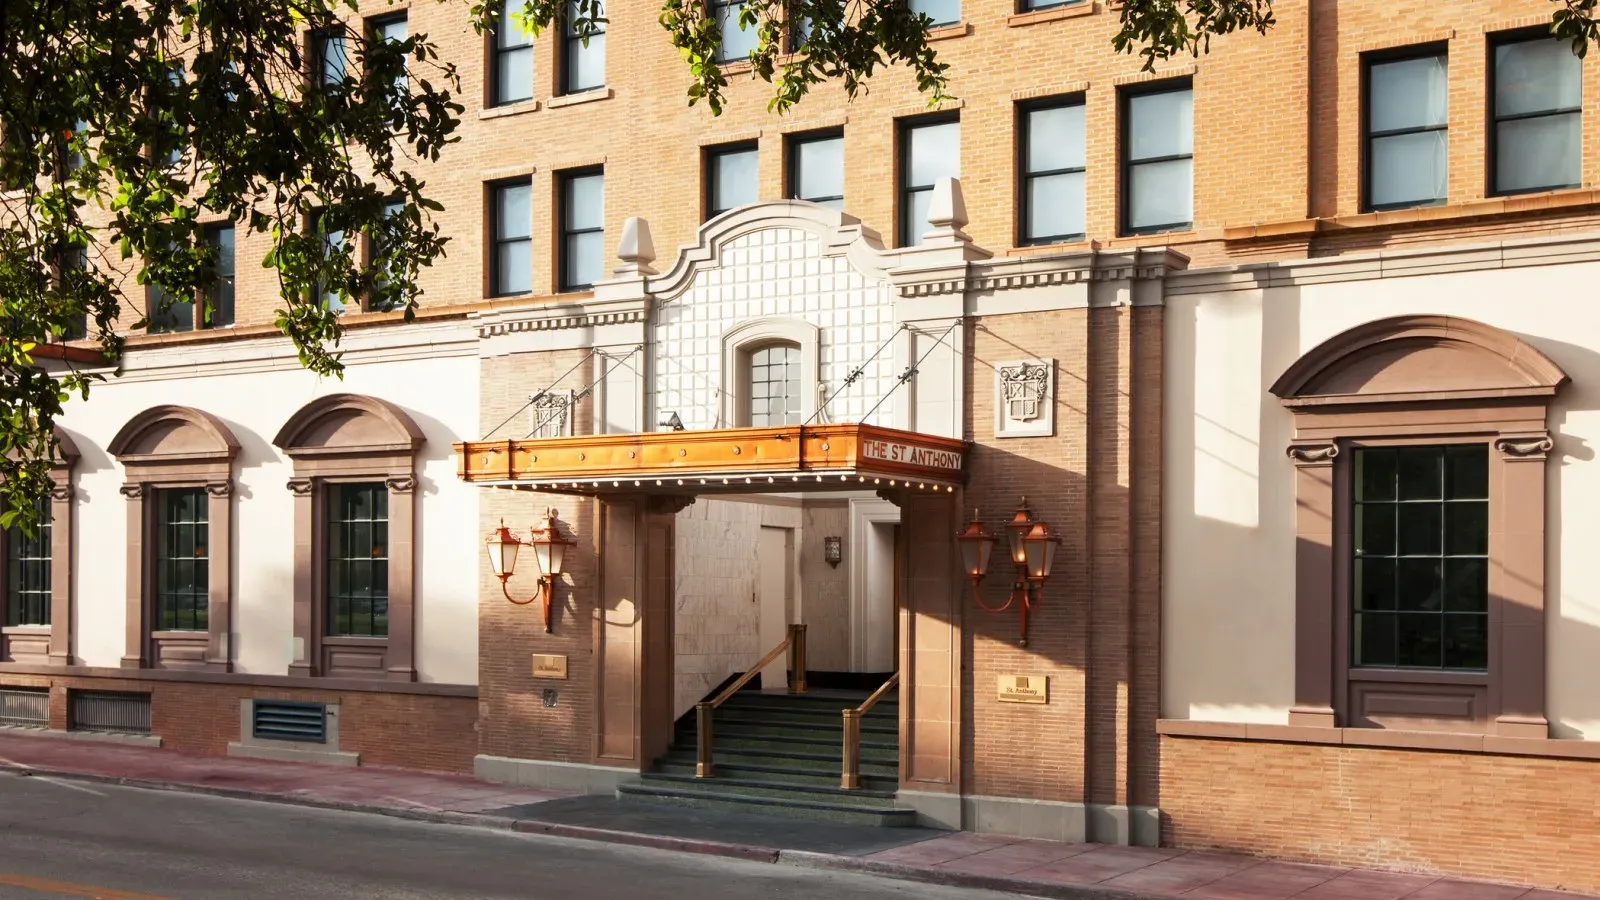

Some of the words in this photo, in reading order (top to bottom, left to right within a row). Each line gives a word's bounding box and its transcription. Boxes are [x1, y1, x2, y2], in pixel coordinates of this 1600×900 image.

[864, 440, 888, 459] THE
[891, 444, 907, 461] ST
[910, 446, 961, 469] ANTHONY
